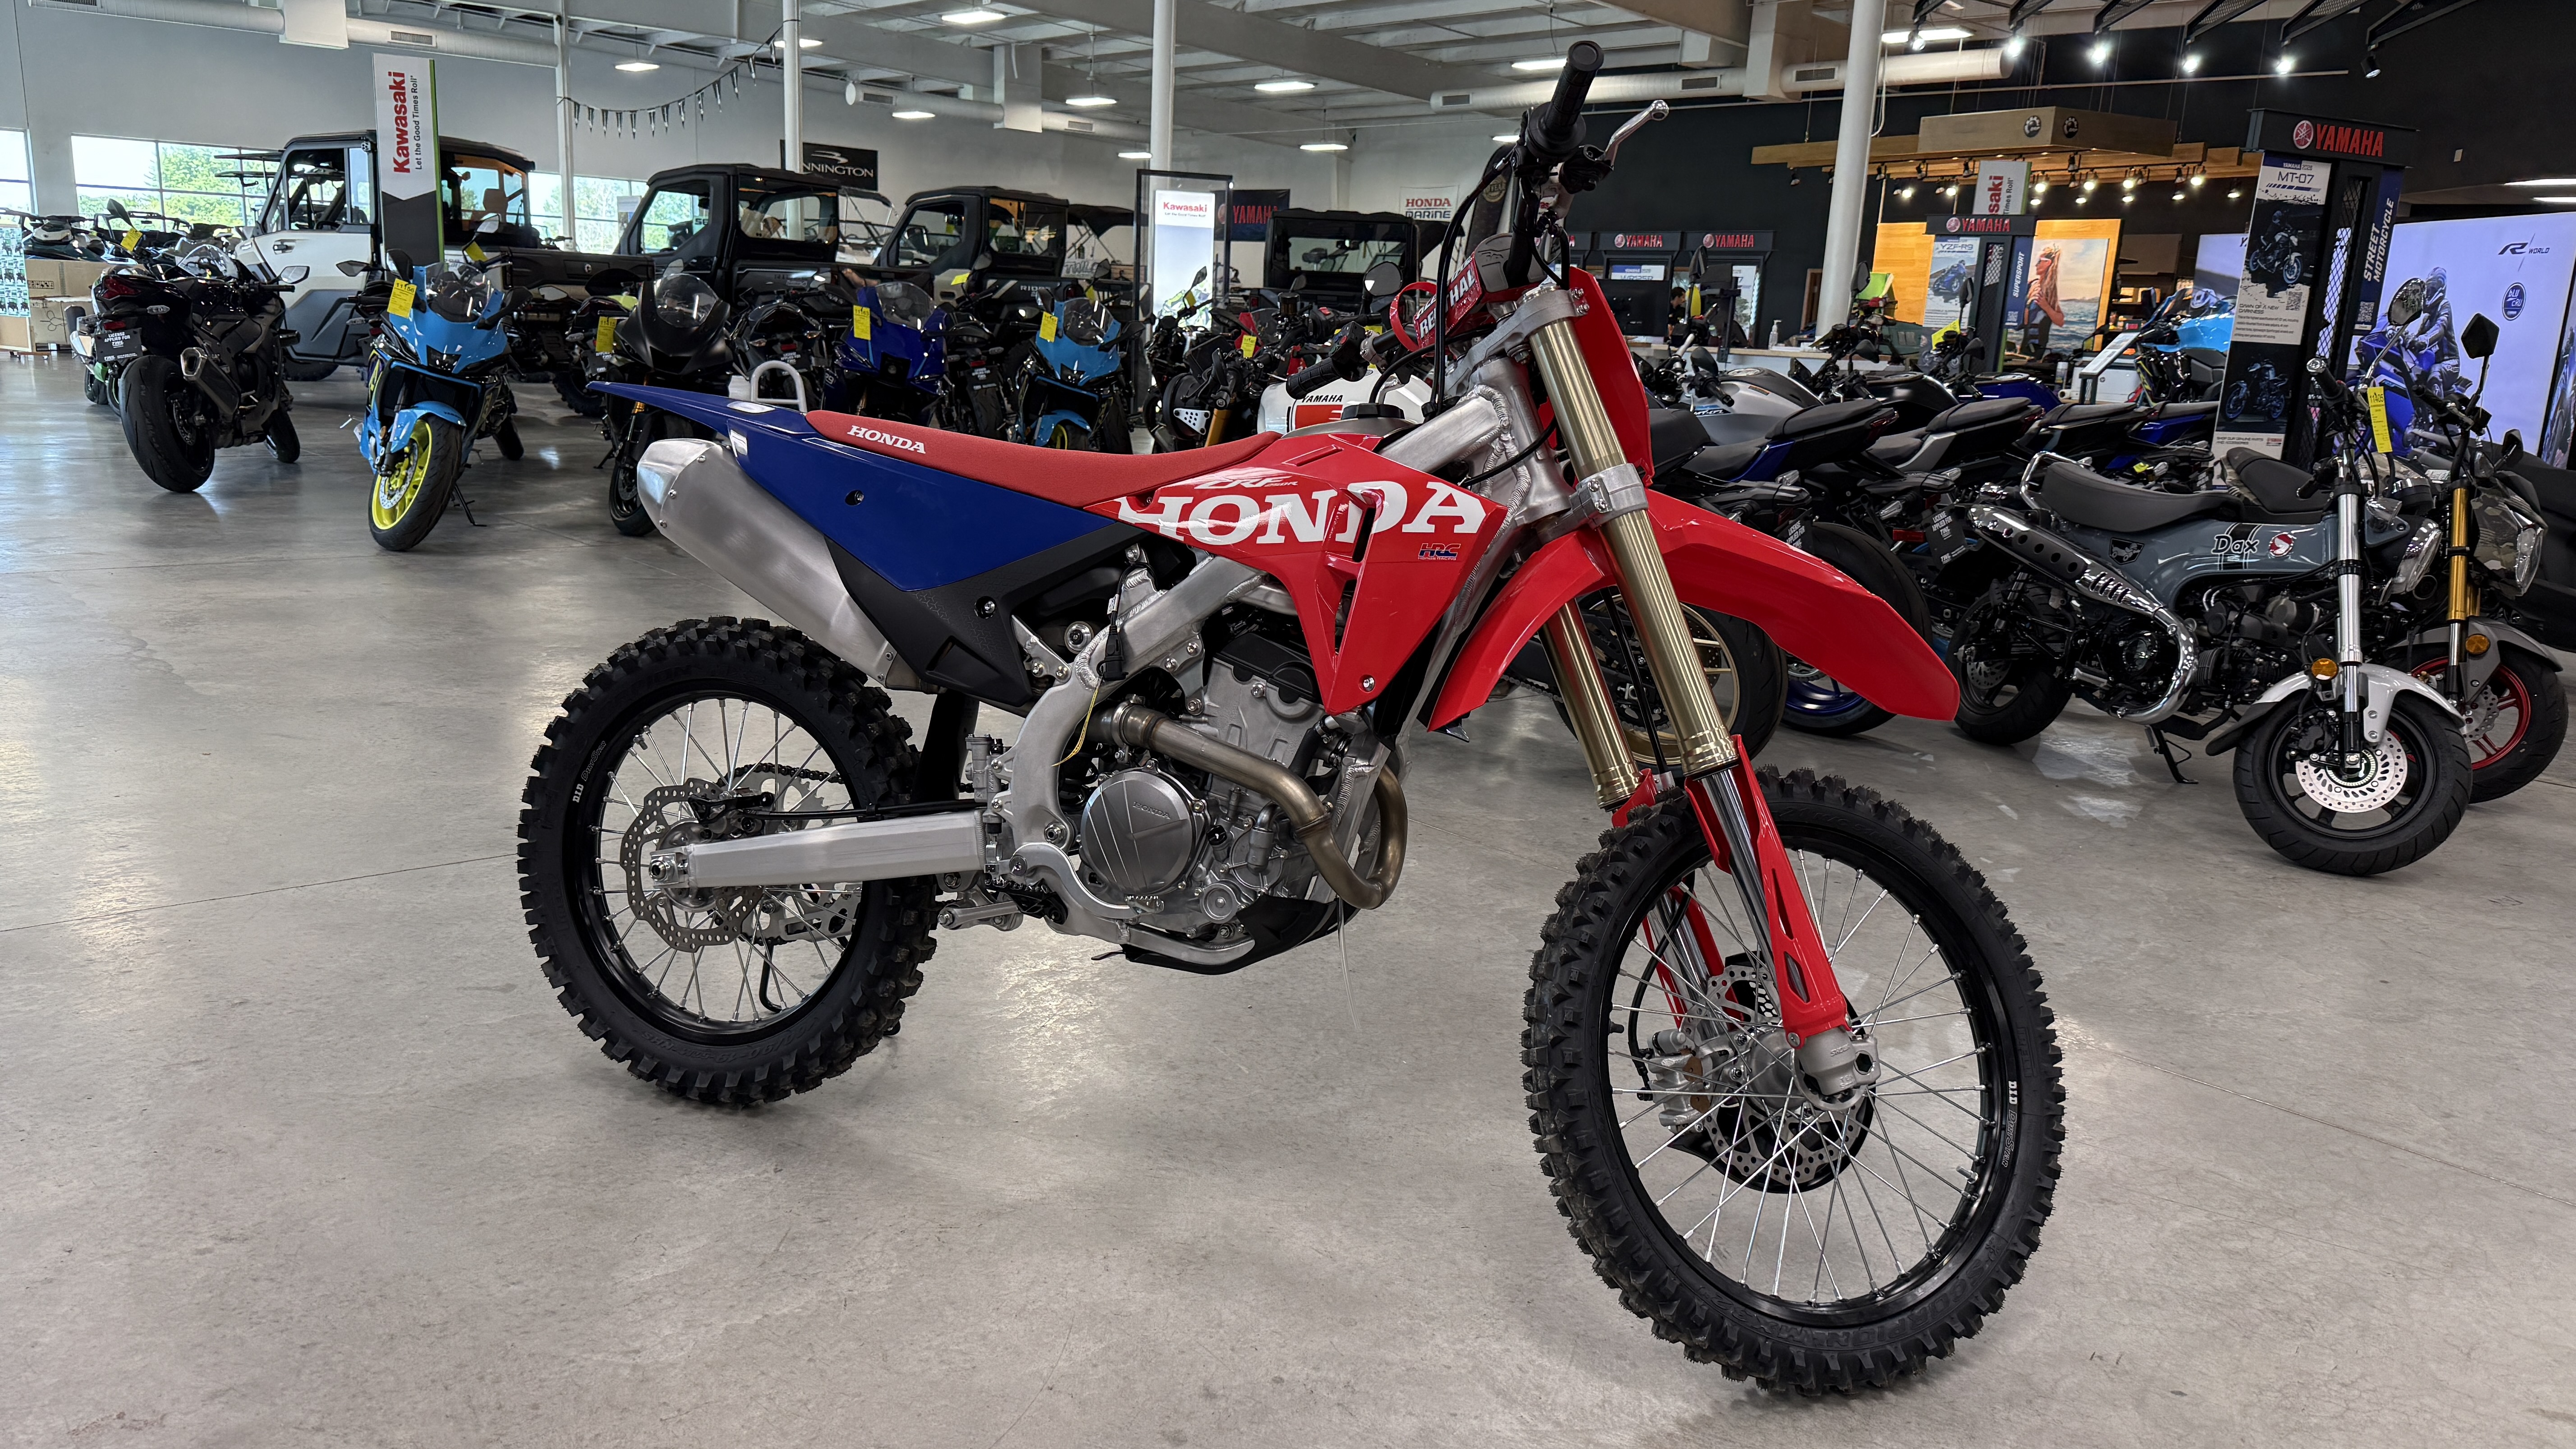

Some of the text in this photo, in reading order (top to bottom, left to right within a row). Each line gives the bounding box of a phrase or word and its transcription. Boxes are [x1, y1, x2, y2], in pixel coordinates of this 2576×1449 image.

[388, 71, 410, 173] Kawasaki
[2316, 124, 2383, 156] YAMAHA
[803, 163, 874, 177] NNINGTON
[2278, 171, 2314, 184] MT-07
[1405, 198, 1452, 207] HONDA
[1988, 175, 2004, 214] saki
[1163, 202, 1207, 212] Kawasaki
[2003, 195, 2011, 214] Times
[1962, 218, 2011, 232] YAMAHA
[1626, 235, 1663, 247] YAMAHA
[1716, 235, 1754, 247] YAMAHA
[2373, 198, 2394, 282] MOTORCYCLE
[2498, 242, 2528, 255] R
[2364, 223, 2380, 281] STREET
[2013, 252, 2025, 298] SUPERSPORT
[1420, 270, 1476, 338] RETHAL
[1302, 395, 1343, 403] YAMAHA
[847, 425, 926, 454] HONDA
[1194, 476, 1293, 489] CRF
[1117, 481, 1486, 544] HONDA
[1418, 543, 1461, 557] HRC
[2211, 534, 2259, 554] Dax
[1133, 802, 1171, 820] HONDA
[1827, 1258, 1989, 1348] SCORPION
